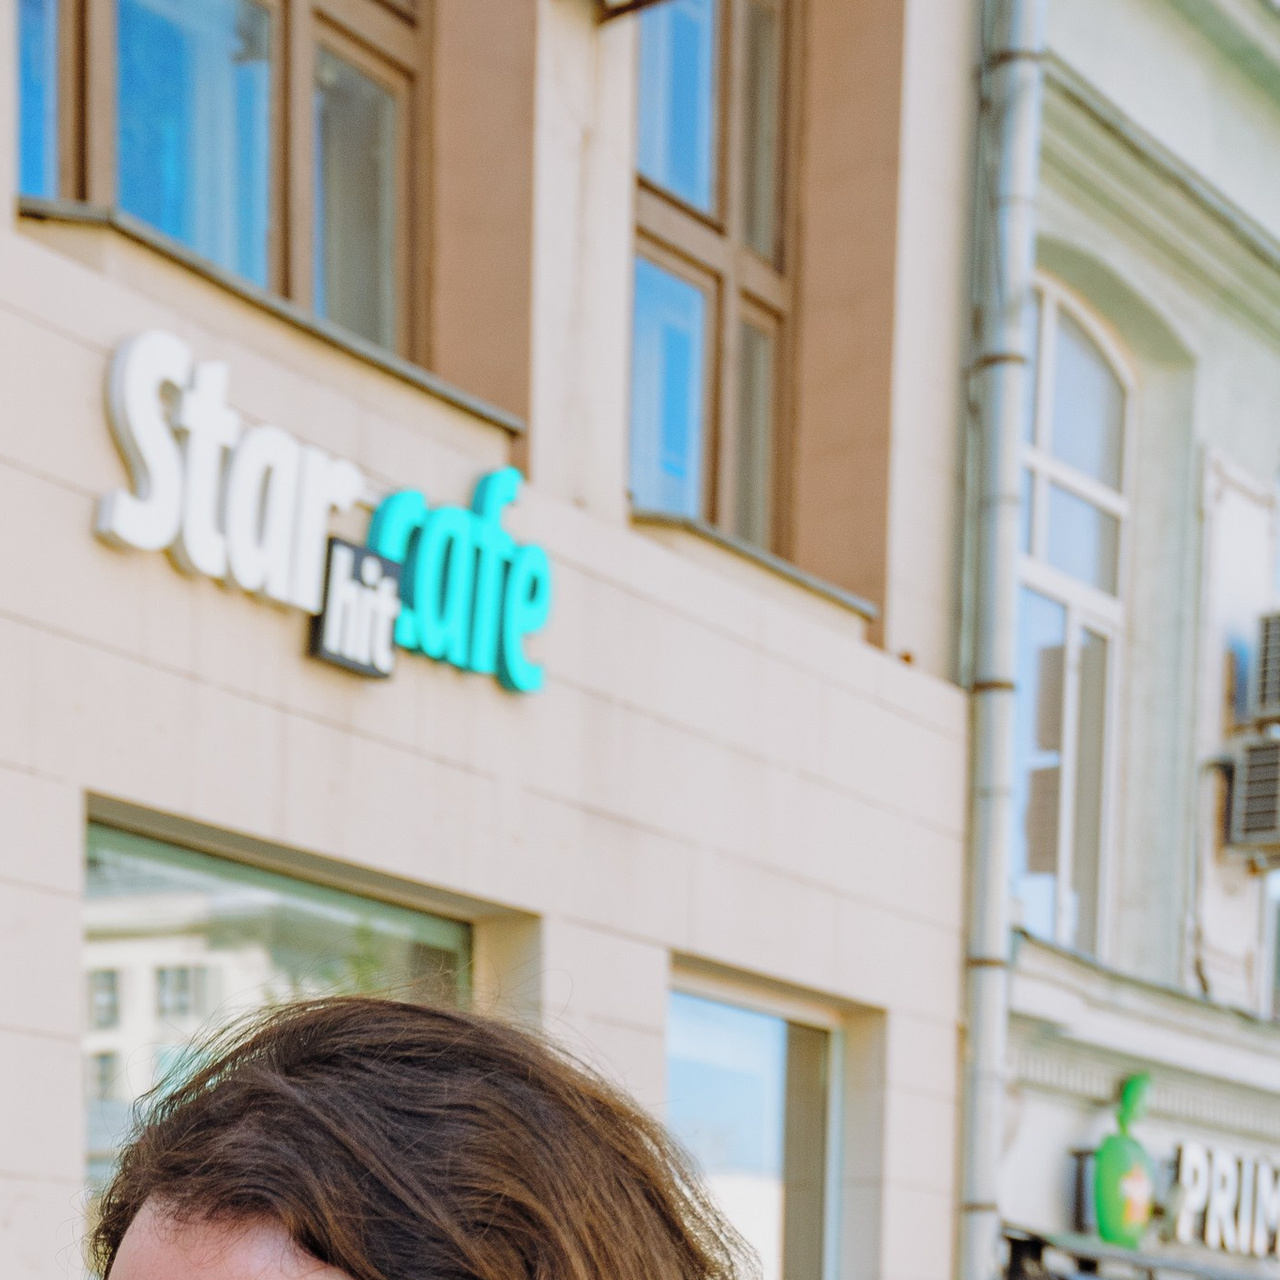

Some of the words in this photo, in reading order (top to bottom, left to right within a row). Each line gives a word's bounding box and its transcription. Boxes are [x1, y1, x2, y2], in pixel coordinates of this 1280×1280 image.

[96, 330, 369, 614] Star
[321, 540, 401, 675] hit
[367, 465, 552, 691] cafe
